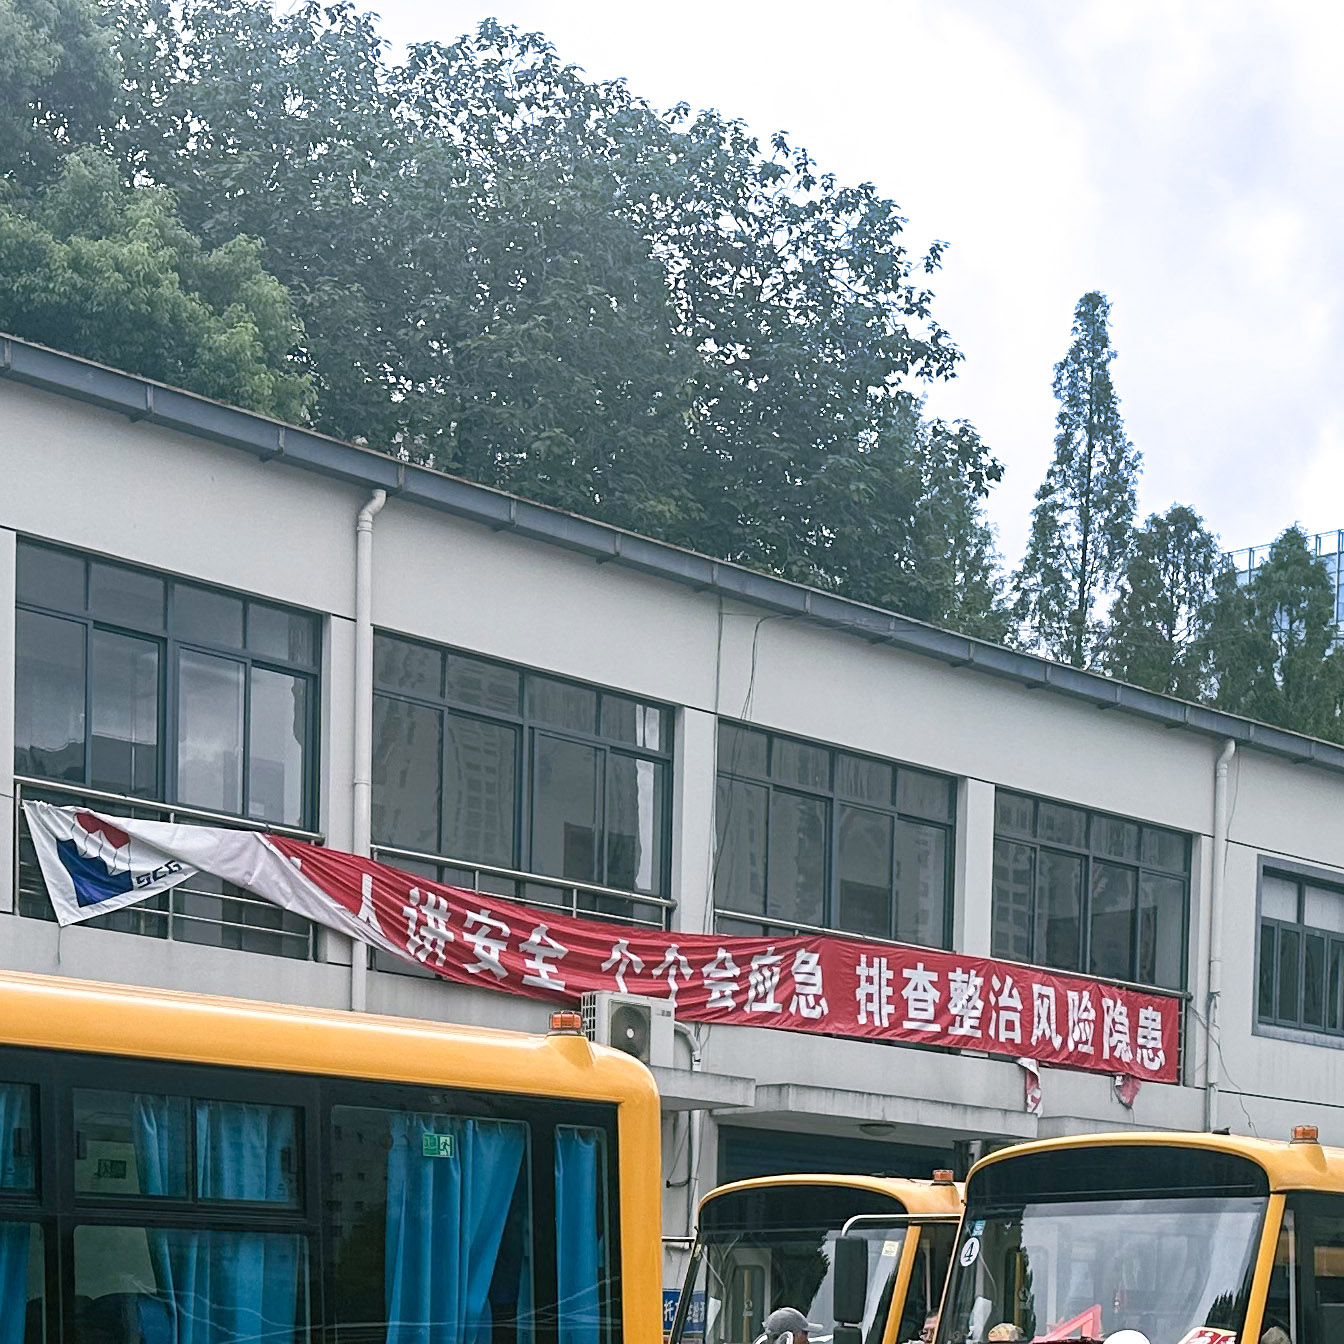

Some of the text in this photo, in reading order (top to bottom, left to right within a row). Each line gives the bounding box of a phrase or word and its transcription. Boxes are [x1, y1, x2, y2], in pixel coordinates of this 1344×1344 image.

[856, 953, 1166, 1071] 排查整治风险隐患
[963, 1241, 975, 1262] 4
